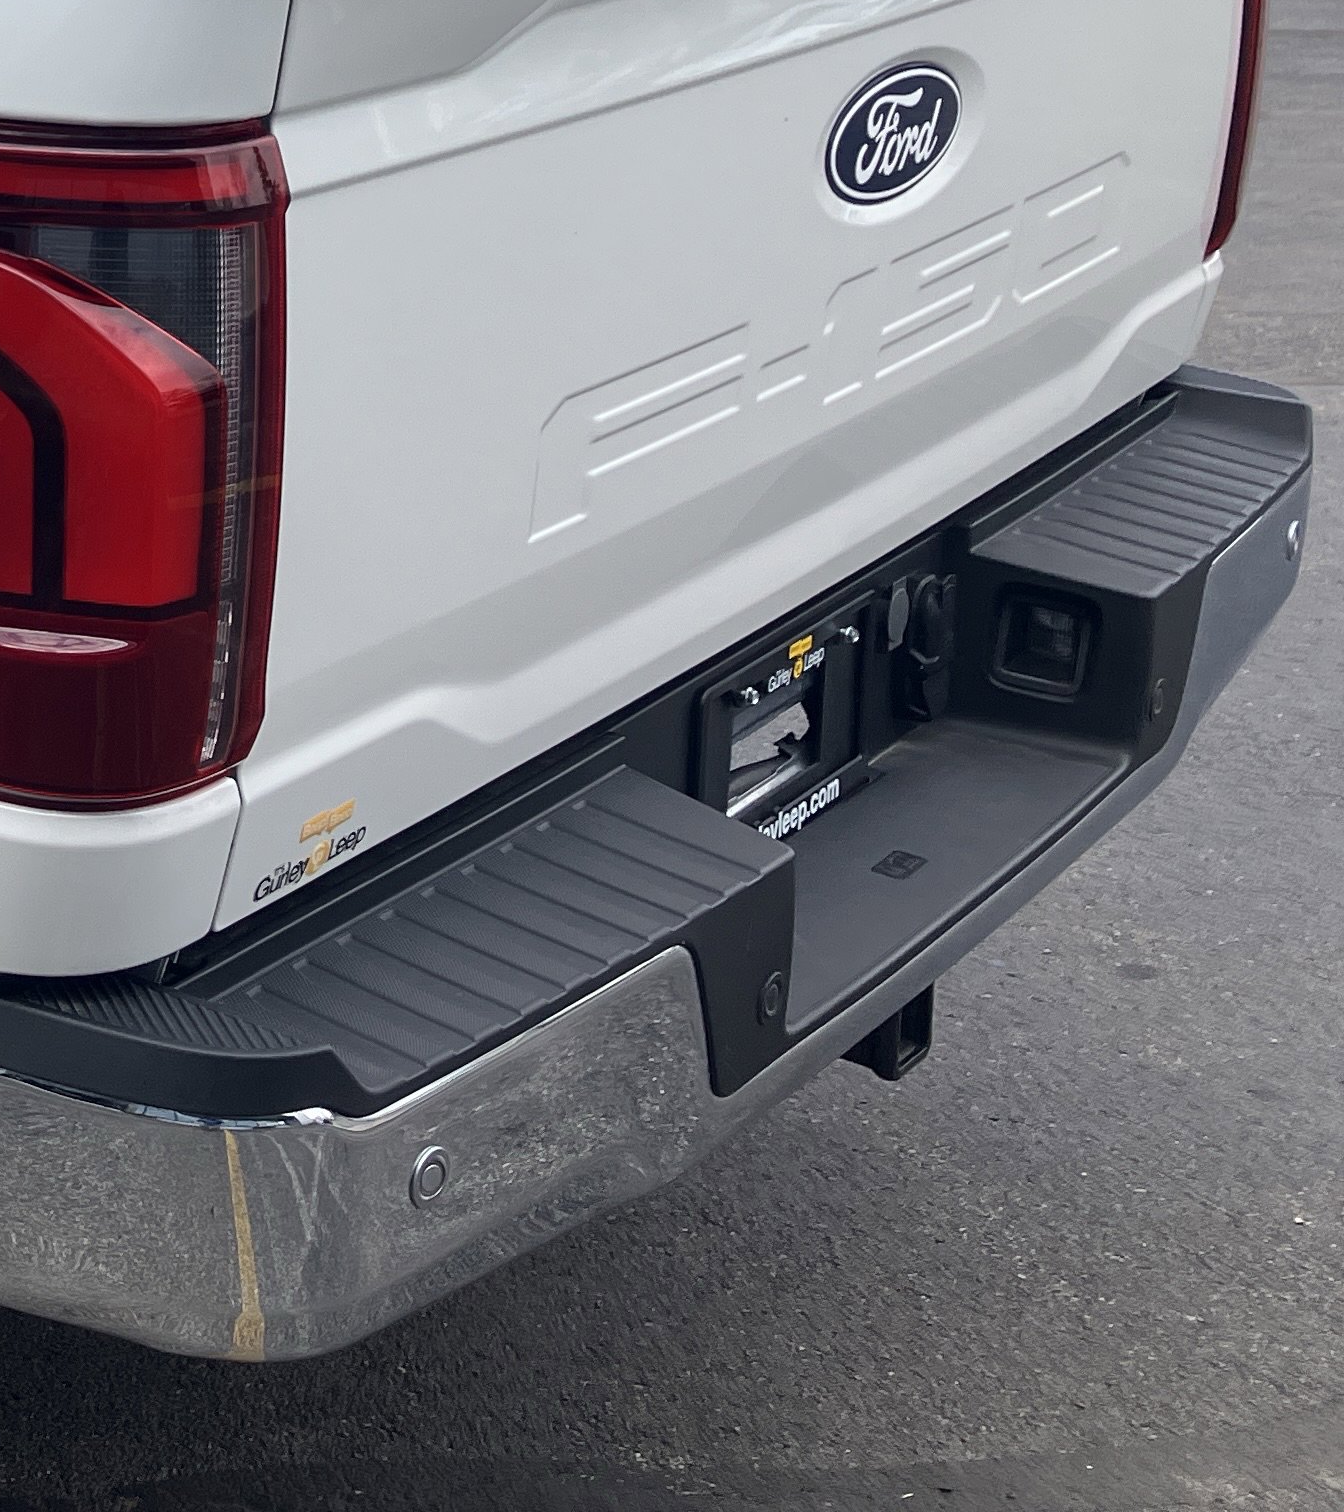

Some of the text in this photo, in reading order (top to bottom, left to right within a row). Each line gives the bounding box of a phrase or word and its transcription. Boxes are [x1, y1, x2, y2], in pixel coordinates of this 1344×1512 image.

[854, 87, 944, 186] Ford
[803, 647, 825, 672] Leep
[253, 825, 367, 903] Gurley Leep
